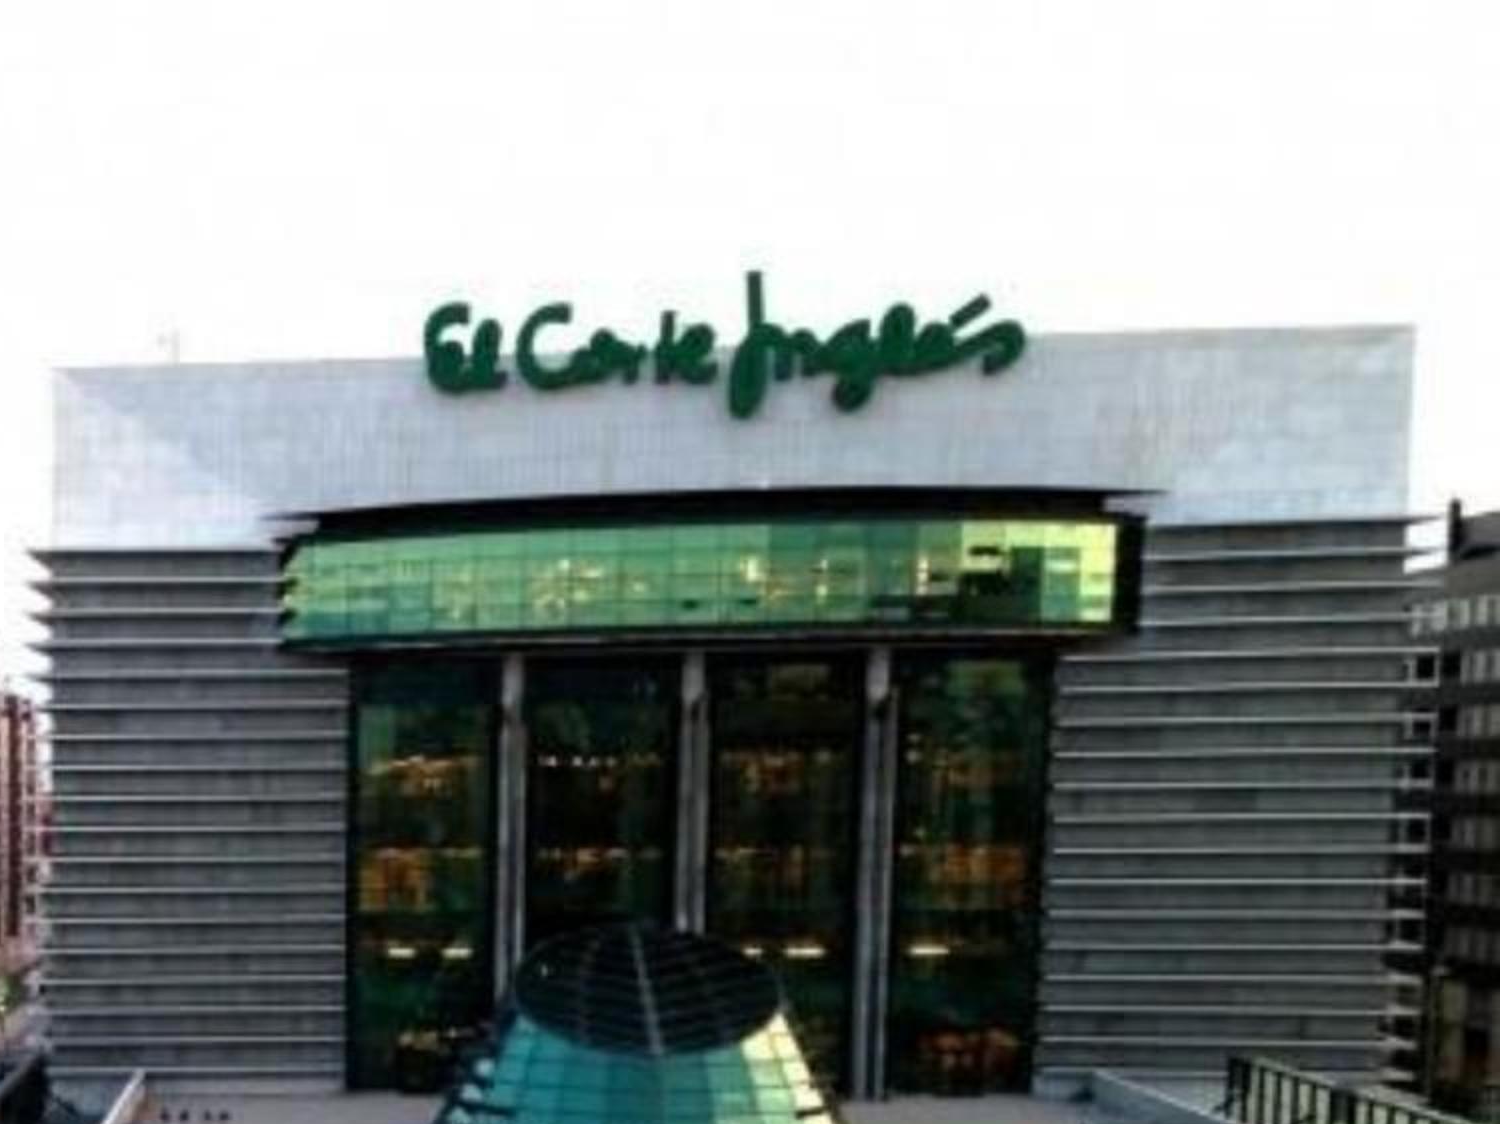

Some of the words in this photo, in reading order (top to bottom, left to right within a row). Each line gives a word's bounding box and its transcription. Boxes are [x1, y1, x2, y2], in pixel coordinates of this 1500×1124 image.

[425, 302, 507, 394] El
[516, 302, 719, 391] Corte
[727, 271, 1026, 420] Inglés
